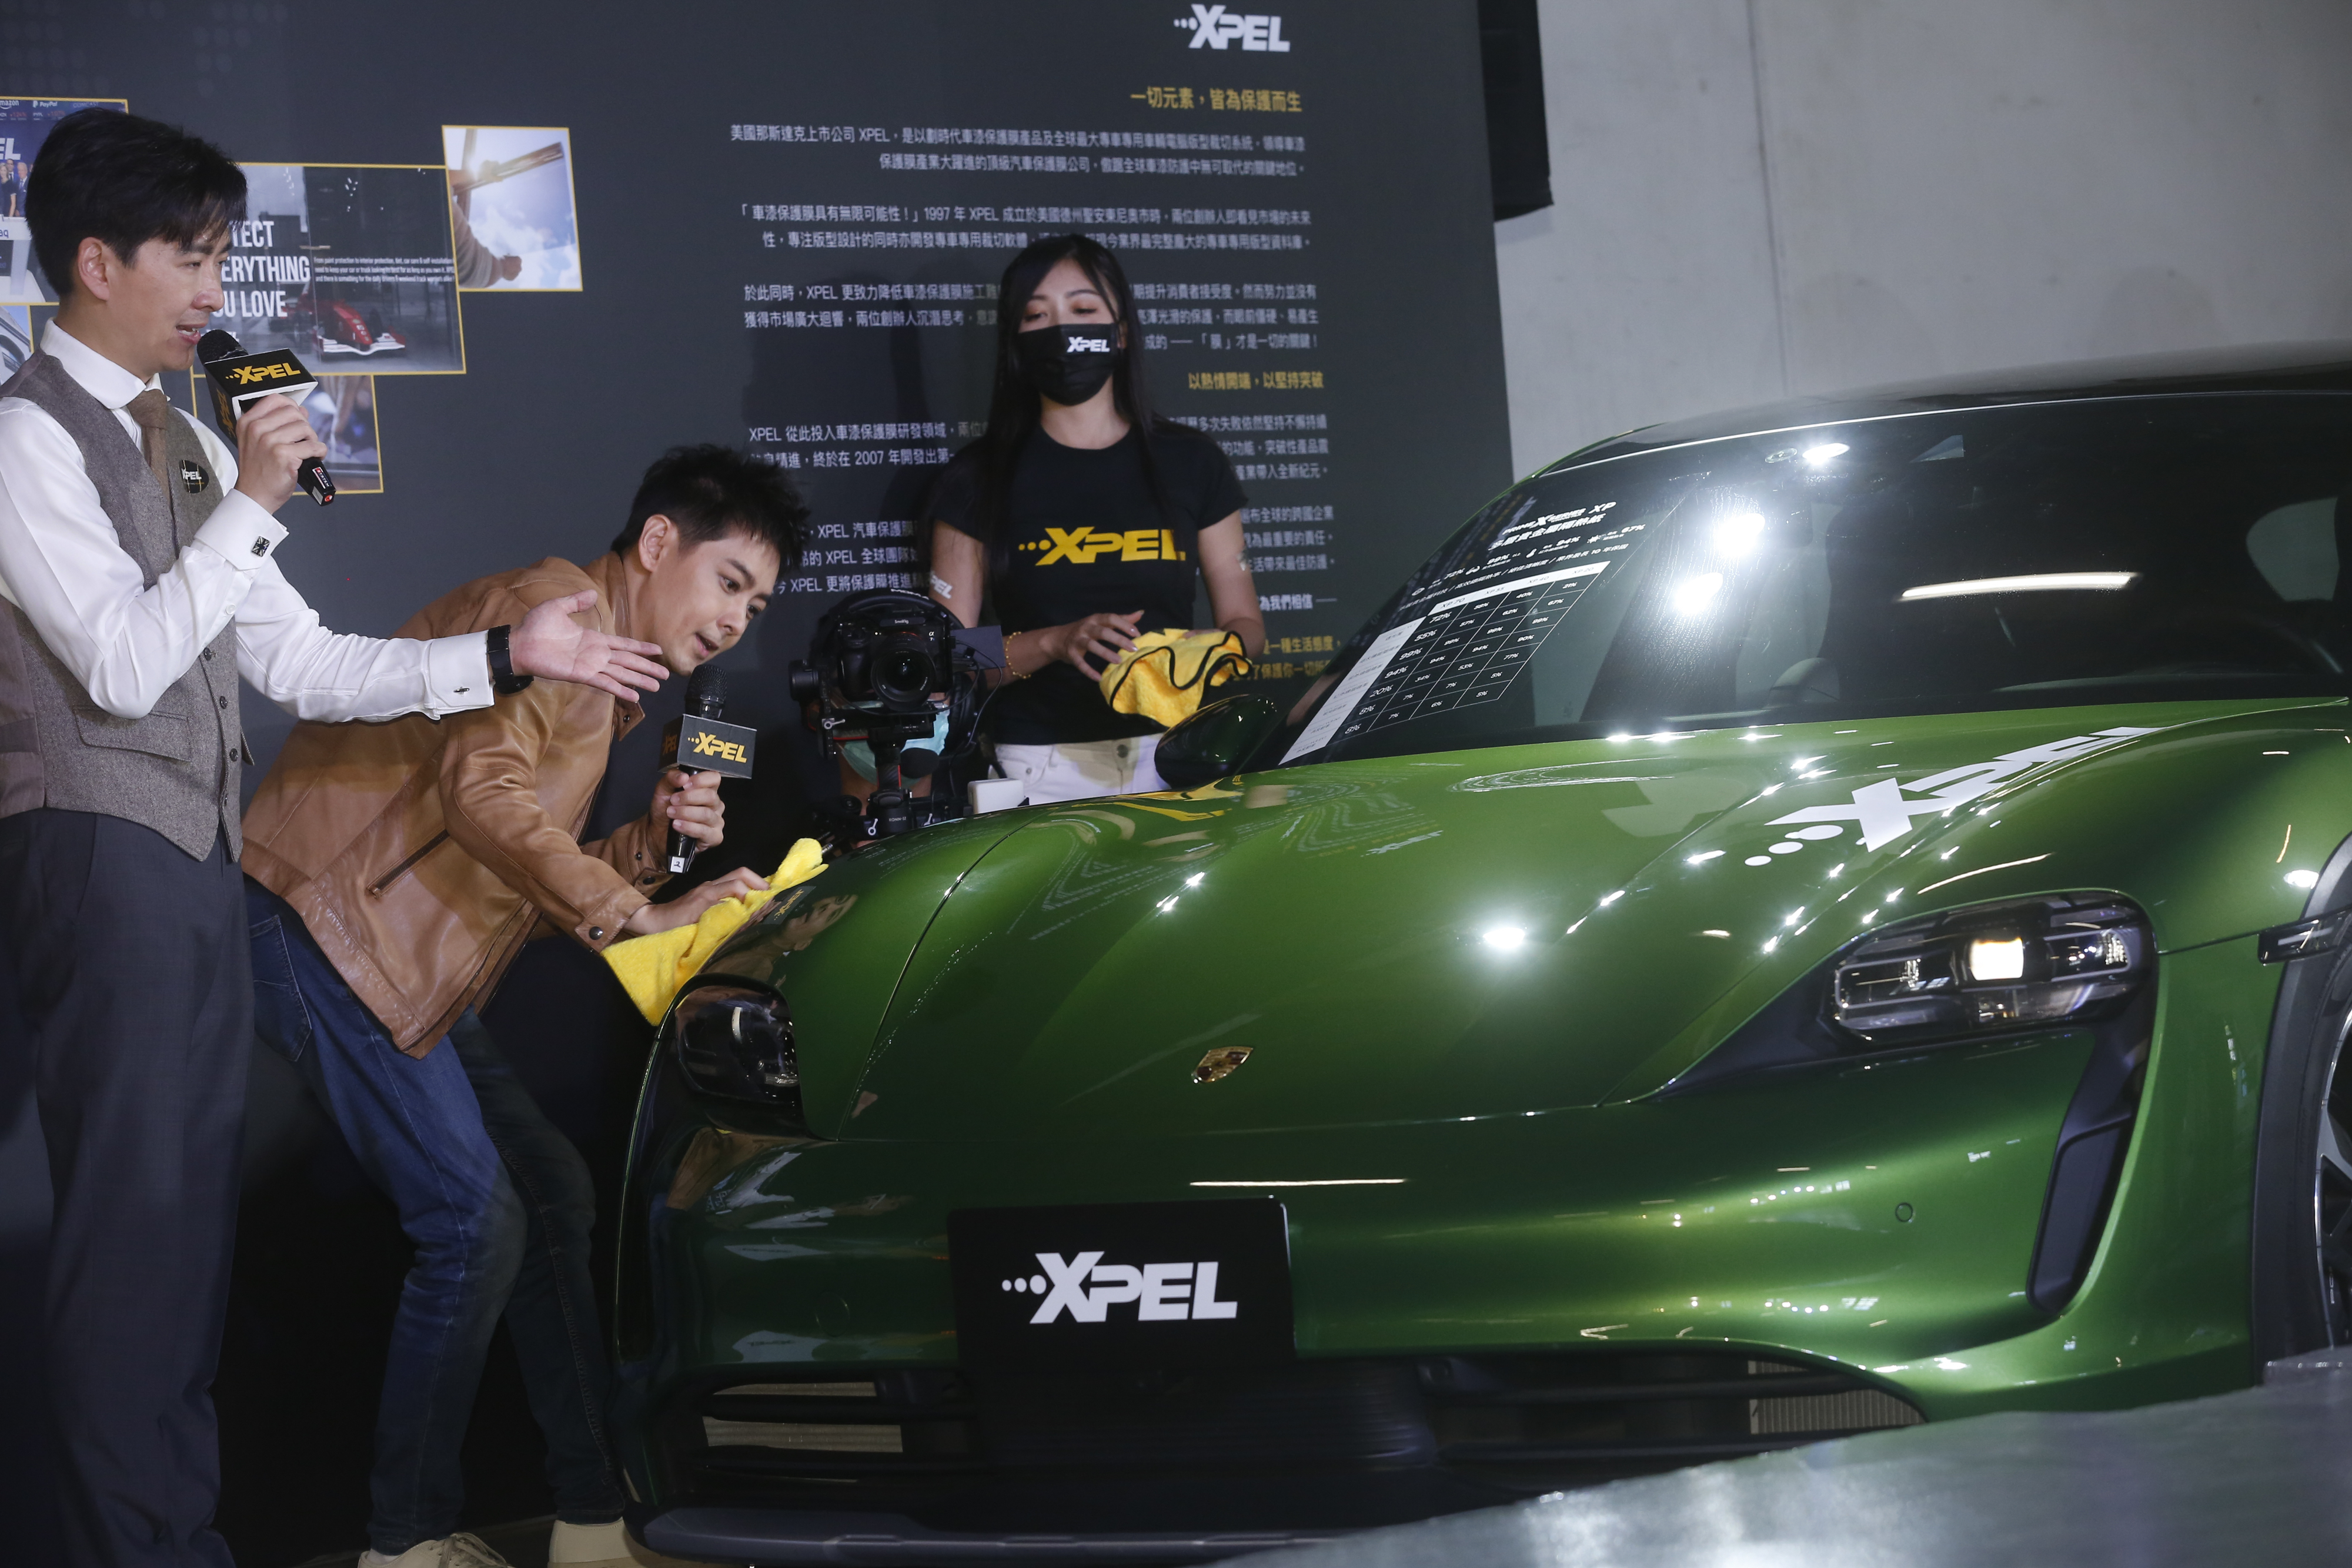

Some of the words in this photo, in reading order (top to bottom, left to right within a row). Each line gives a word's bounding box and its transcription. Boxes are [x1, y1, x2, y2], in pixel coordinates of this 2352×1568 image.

[1188, 4, 1291, 52] XPEL
[1130, 86, 1303, 112] 一切元素，皆為保護而生
[970, 207, 999, 223] XPEL
[240, 290, 288, 318] LOVE
[1067, 337, 1111, 353] XPEL
[232, 362, 301, 385] XPEL
[749, 427, 781, 442] XPEL
[855, 450, 884, 466] 2007
[182, 469, 202, 480] XPEL
[1589, 501, 1616, 514] XP
[1621, 524, 1646, 534] 67%
[1035, 526, 1186, 566] XPEL
[1556, 536, 1581, 546] 94%
[826, 550, 858, 565] XPEL
[1487, 553, 1511, 565] 99%
[1444, 567, 1466, 580] 72%
[791, 577, 822, 593] XPEL
[1429, 611, 1452, 624] 72%
[1414, 629, 1438, 641] 55%
[1399, 647, 1423, 660] 99%
[1384, 666, 1409, 678] 94%
[1369, 684, 1394, 698] 20%
[1359, 704, 1376, 715] 8%
[1344, 724, 1361, 734] 8%
[693, 731, 747, 763] XPEL
[1030, 1251, 1238, 1325] XPEL
